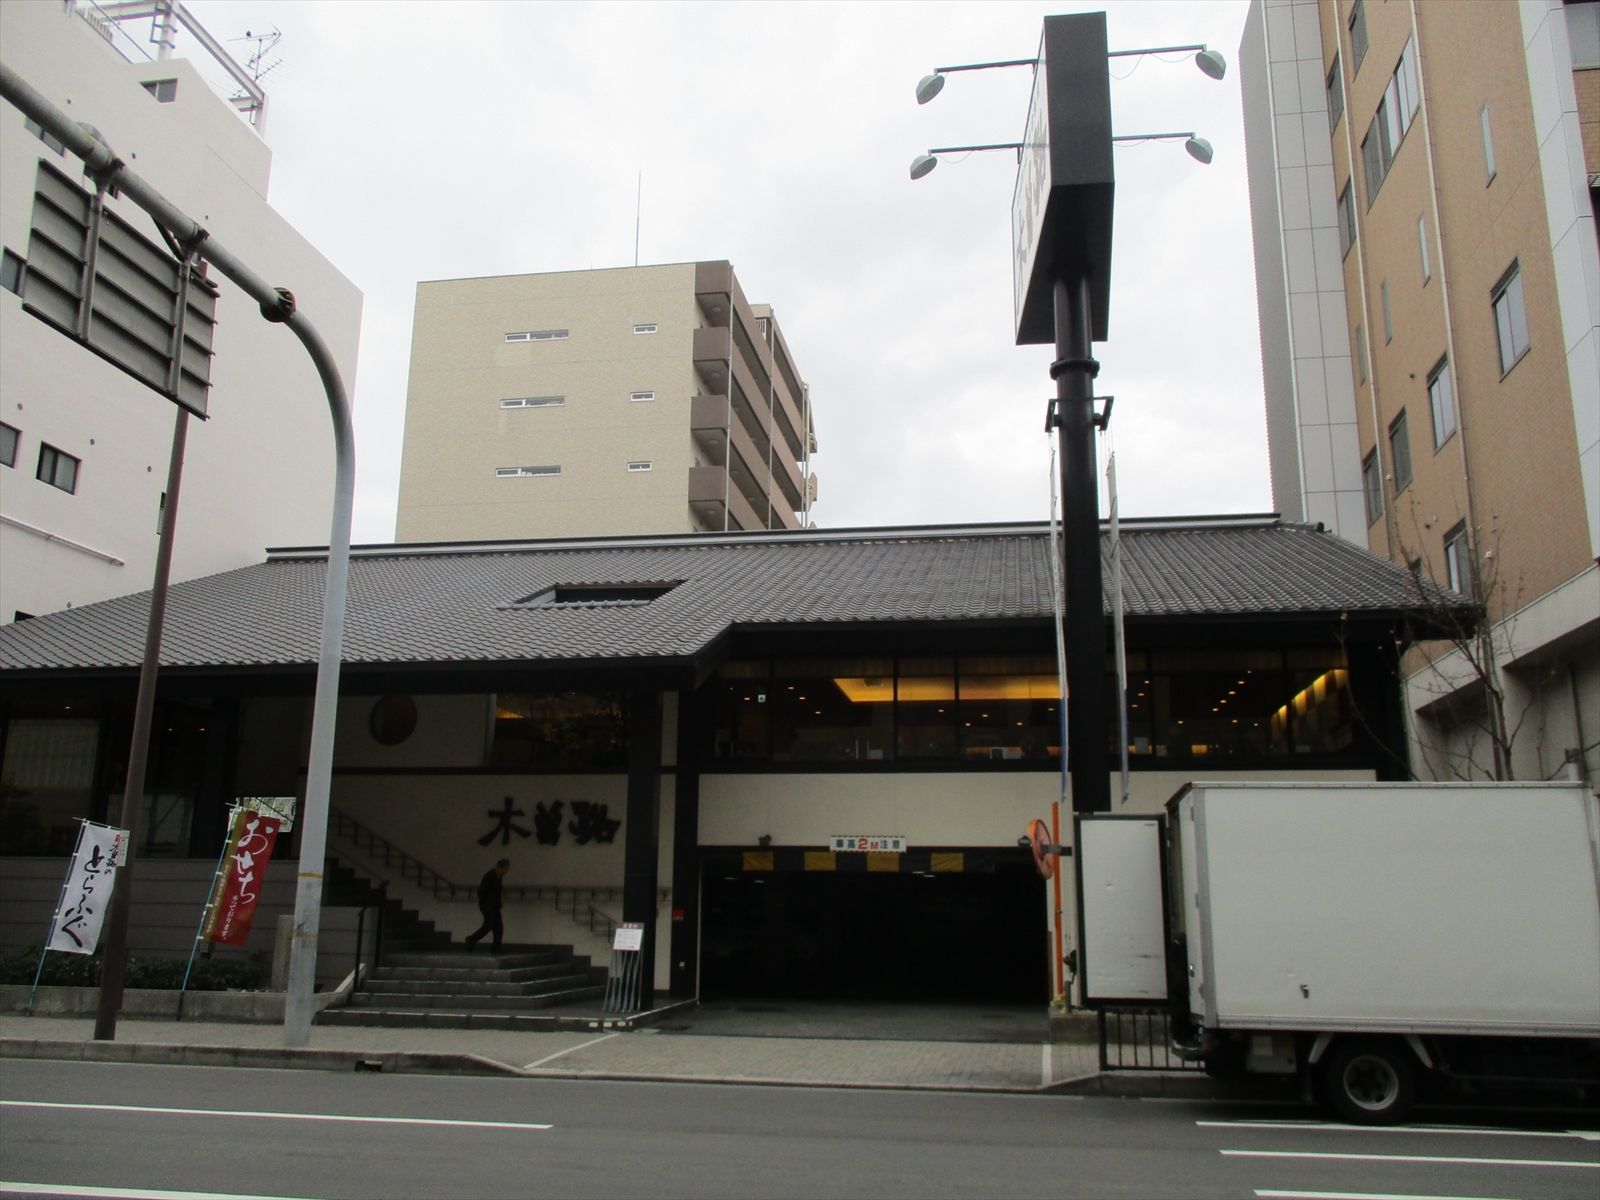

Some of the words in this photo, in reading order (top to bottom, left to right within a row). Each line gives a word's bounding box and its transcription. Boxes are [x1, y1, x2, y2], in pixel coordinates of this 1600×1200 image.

[231, 819, 274, 905] おせち
[478, 797, 621, 846] 木曽路
[62, 844, 105, 948] とらふぐ
